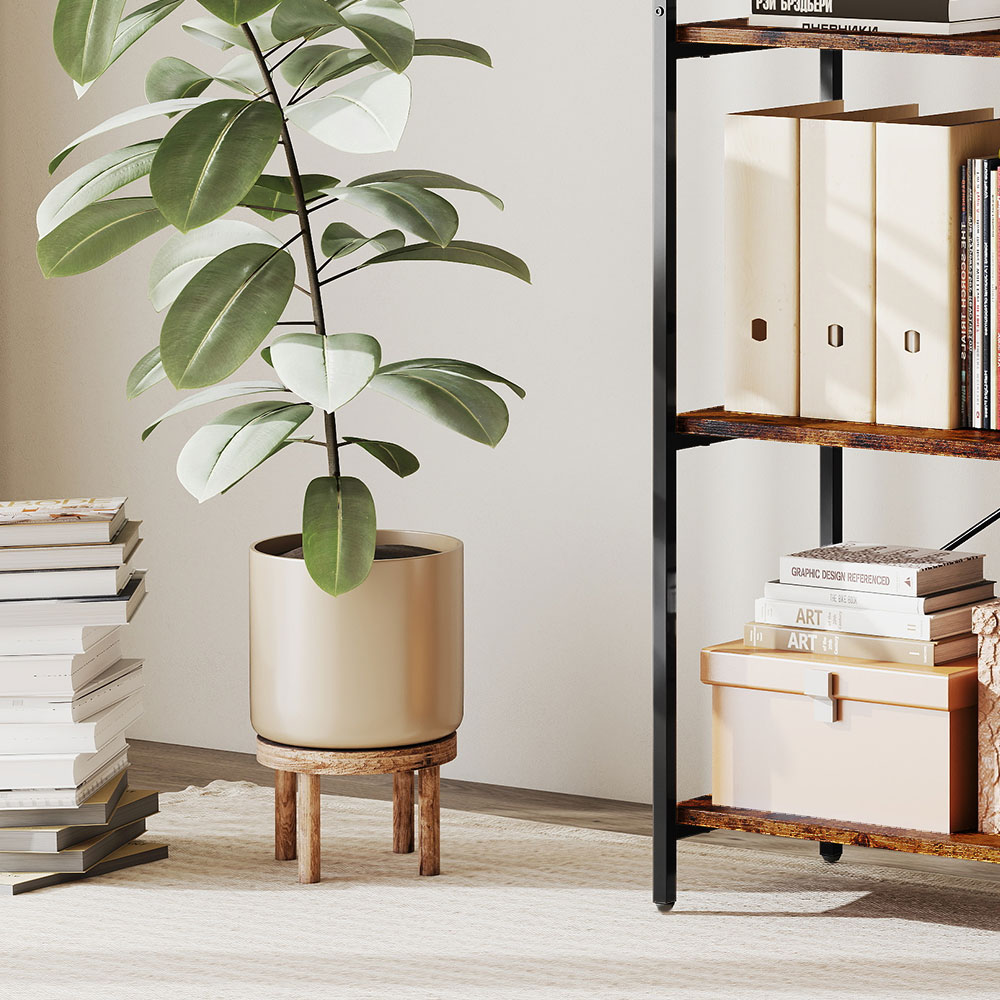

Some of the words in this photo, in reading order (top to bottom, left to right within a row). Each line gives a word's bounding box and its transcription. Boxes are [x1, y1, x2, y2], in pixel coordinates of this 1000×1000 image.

[0, 498, 111, 507] BODE
[791, 566, 820, 579] GRAPHIC
[822, 570, 846, 582] DESIGN
[847, 572, 890, 586] REFERENCED
[796, 607, 823, 626] ART
[787, 632, 818, 651] ART
